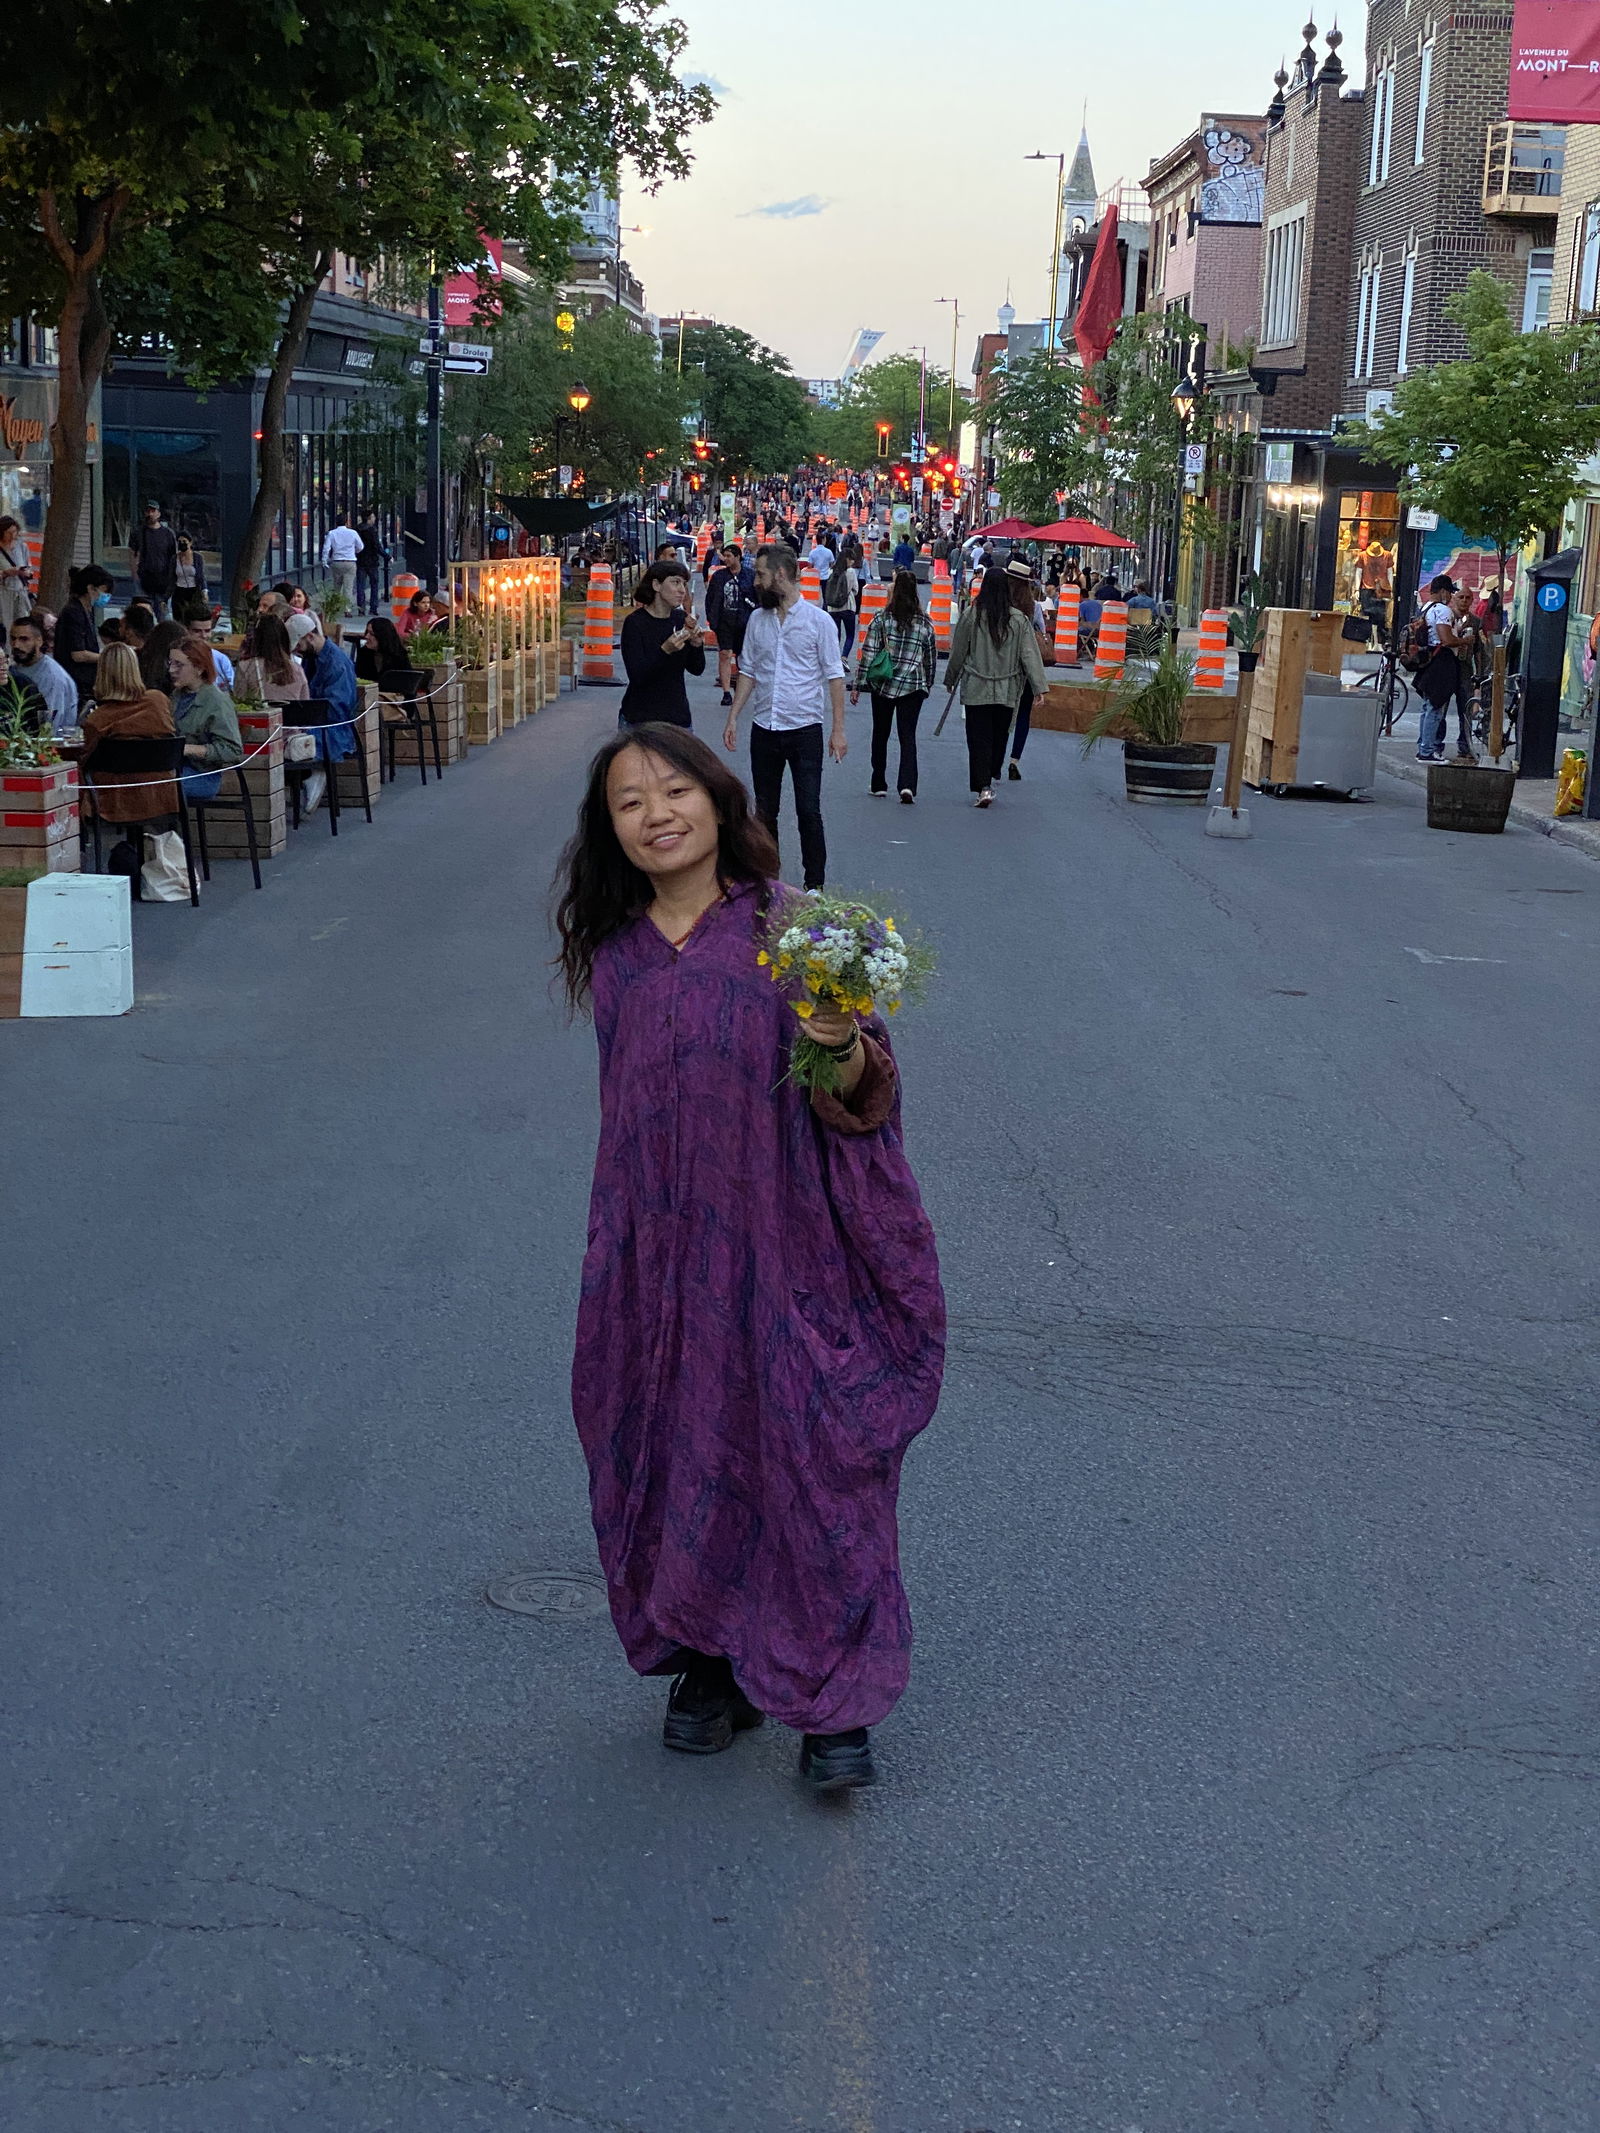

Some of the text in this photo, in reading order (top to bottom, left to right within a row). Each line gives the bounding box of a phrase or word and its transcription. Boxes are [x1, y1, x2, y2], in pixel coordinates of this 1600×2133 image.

[1519, 48, 1569, 57] L'AVENUE DU
[462, 347, 488, 358] Drolet
